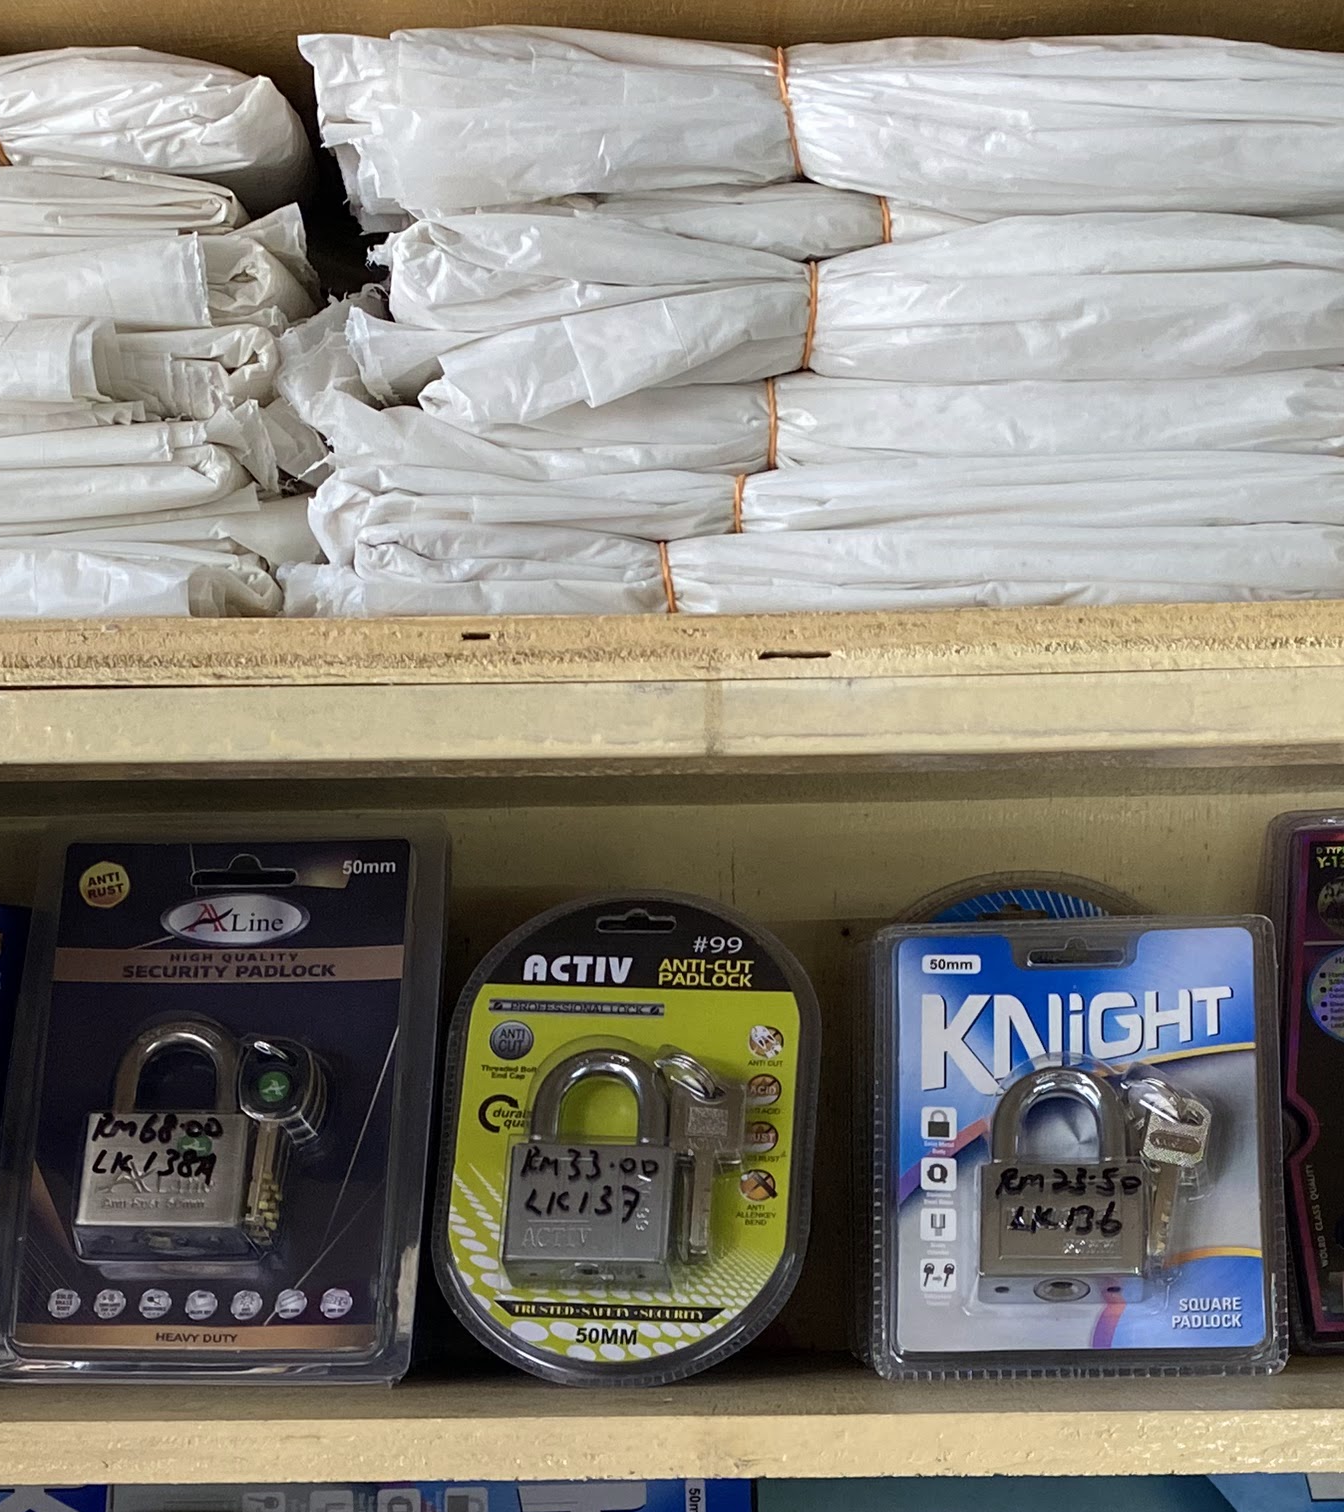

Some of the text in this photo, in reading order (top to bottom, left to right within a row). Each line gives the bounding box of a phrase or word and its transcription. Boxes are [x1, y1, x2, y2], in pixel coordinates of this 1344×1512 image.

[342, 859, 396, 875] 50mm
[87, 873, 121, 888] ANTI
[87, 883, 124, 899] RUST
[692, 936, 743, 954] #99
[169, 951, 299, 963] HIGH QUALITY
[122, 963, 336, 979] SECURITY PADLOCK
[523, 954, 633, 984] ACTIV
[658, 957, 754, 973] ANTI-CUT
[929, 958, 973, 972] 50mm
[658, 972, 753, 987] PADLOCK
[499, 1028, 525, 1039] ANTI
[498, 1039, 524, 1051] CUT
[1179, 1298, 1242, 1312] SQUARE
[1172, 1312, 1242, 1329] PADLOCK
[155, 1331, 239, 1345] HEAVY DUTY
[575, 1327, 638, 1345] 50MM
